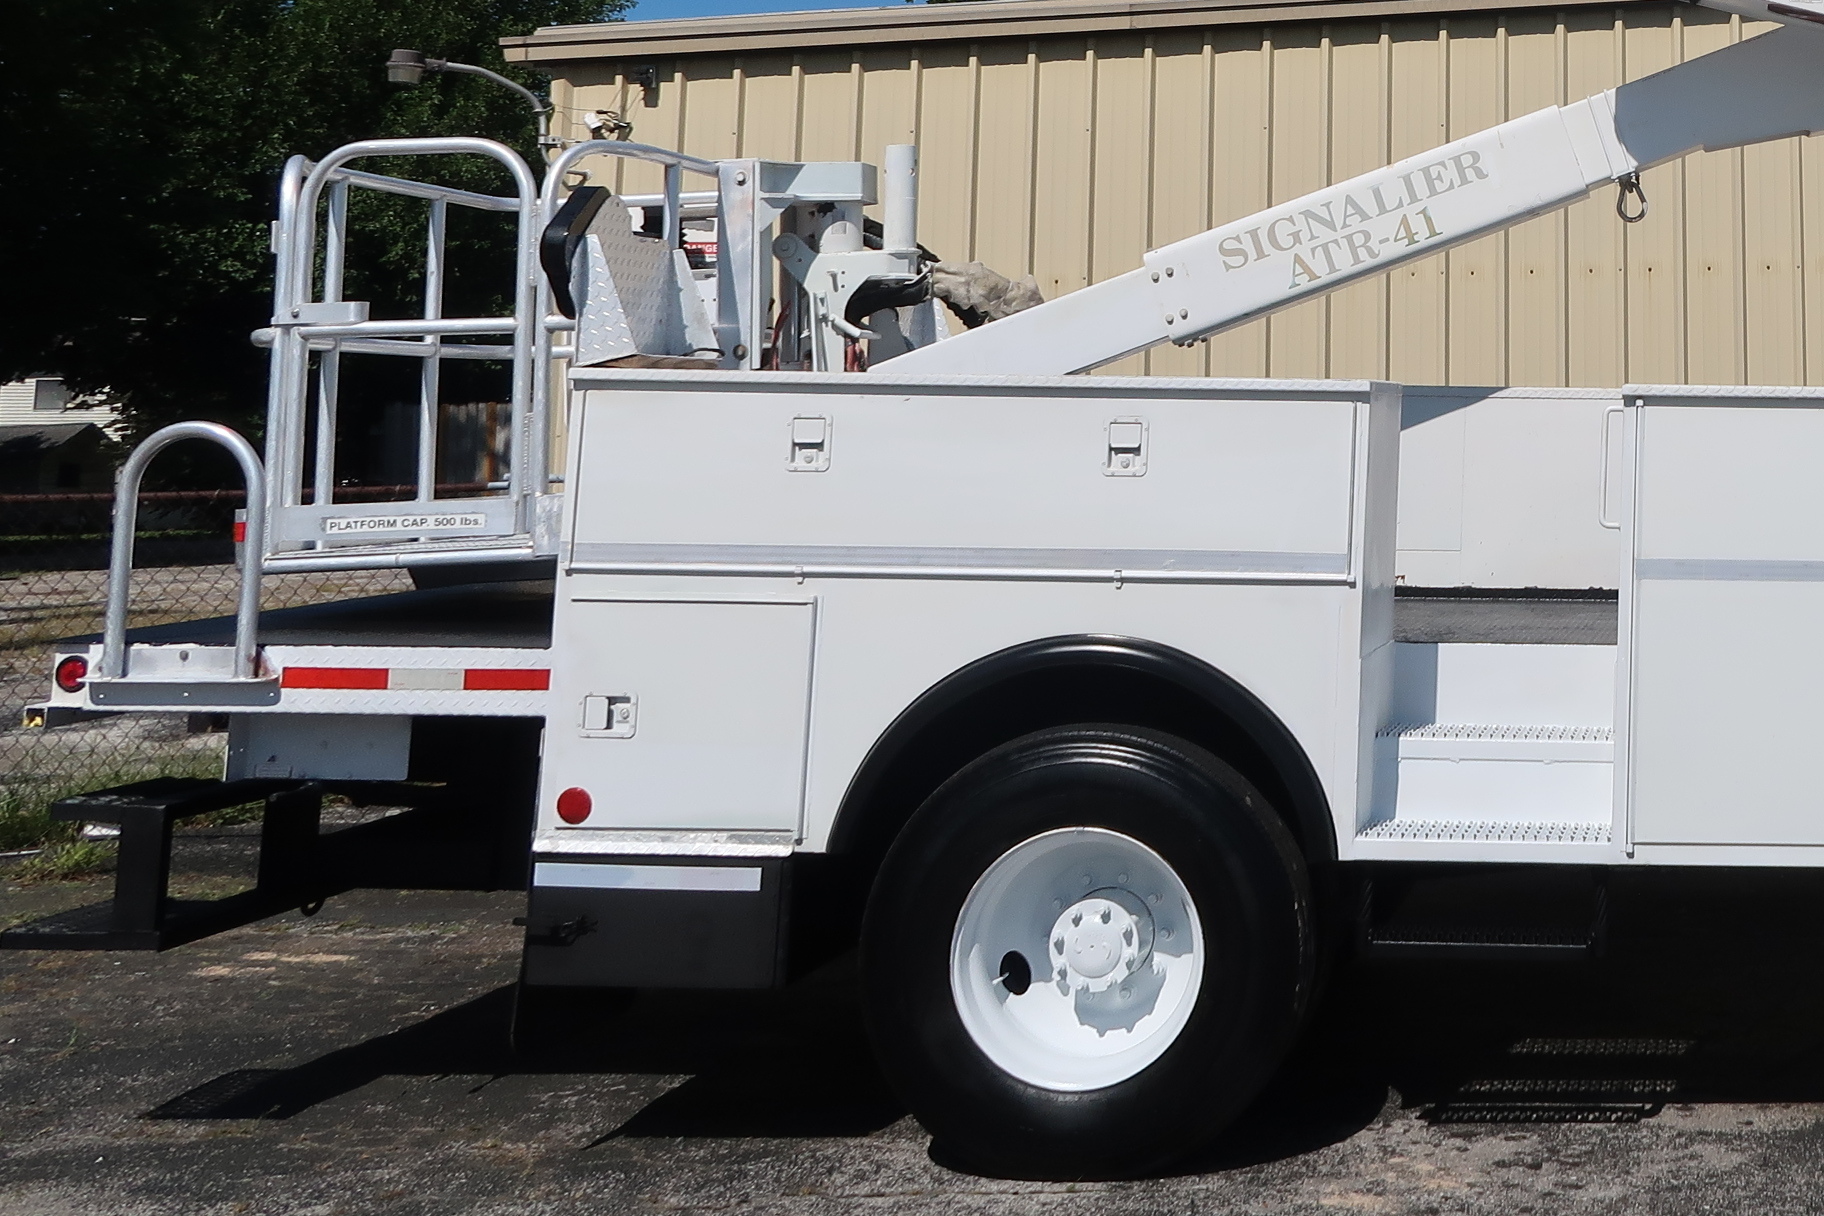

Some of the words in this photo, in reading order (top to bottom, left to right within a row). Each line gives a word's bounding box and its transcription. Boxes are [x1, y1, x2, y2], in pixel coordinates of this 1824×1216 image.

[1217, 149, 1489, 273] SIGNALIER
[683, 244, 718, 252] ANGE
[1288, 206, 1444, 290] ATR-41
[329, 518, 397, 531] PLATFORM
[401, 517, 430, 528] CAP.
[434, 517, 456, 527] 500
